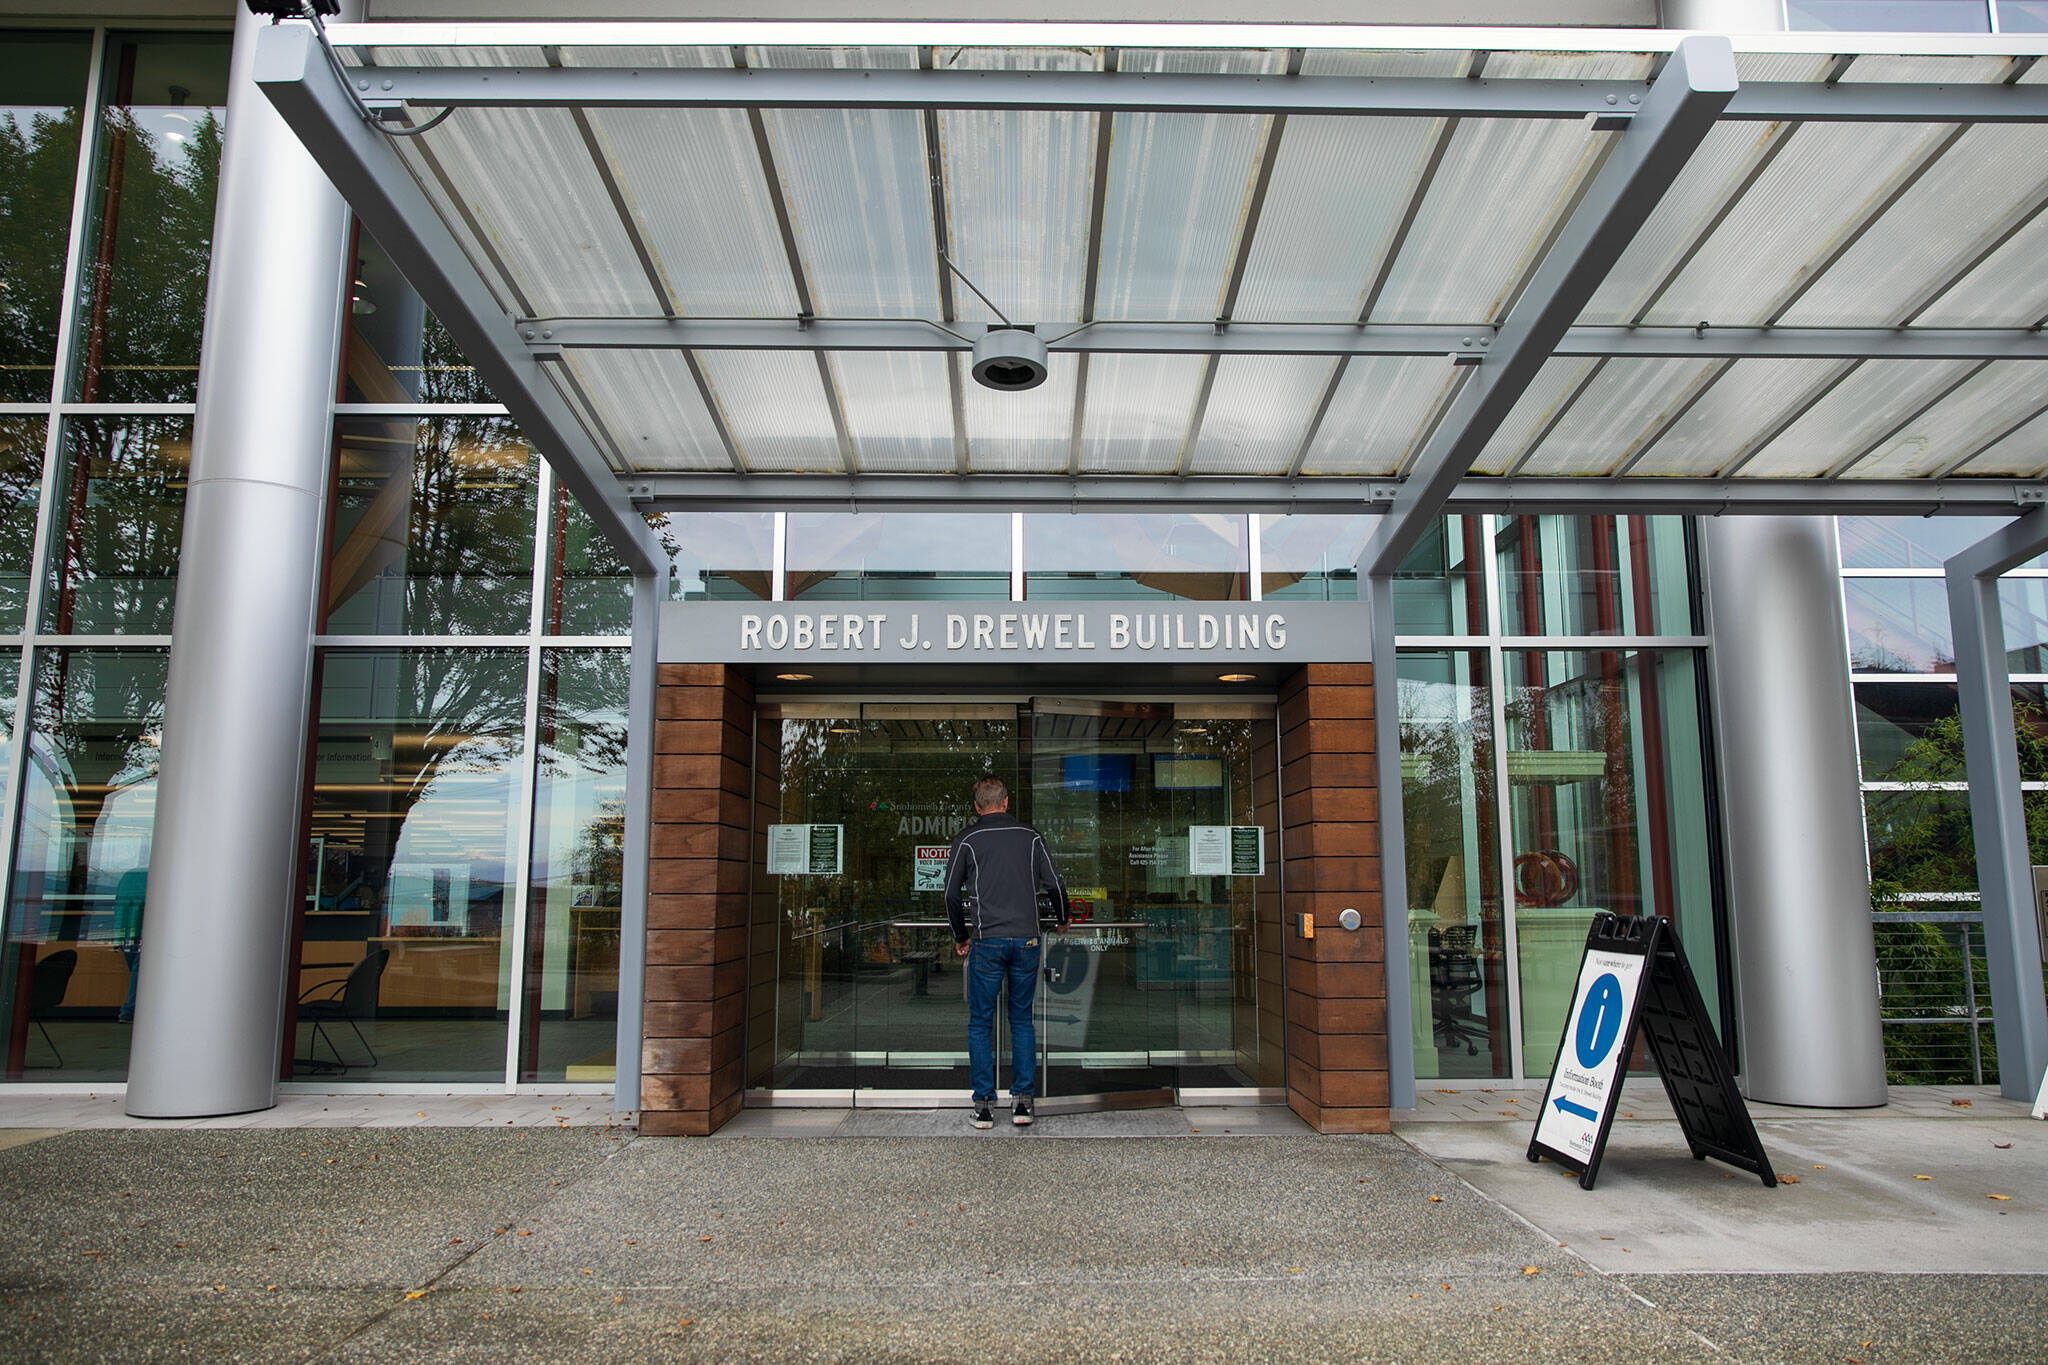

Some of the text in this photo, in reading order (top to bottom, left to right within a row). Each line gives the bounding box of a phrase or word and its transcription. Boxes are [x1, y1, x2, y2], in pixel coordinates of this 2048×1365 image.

[740, 613, 1288, 650] ROBERT J. DREWEL BUILDING
